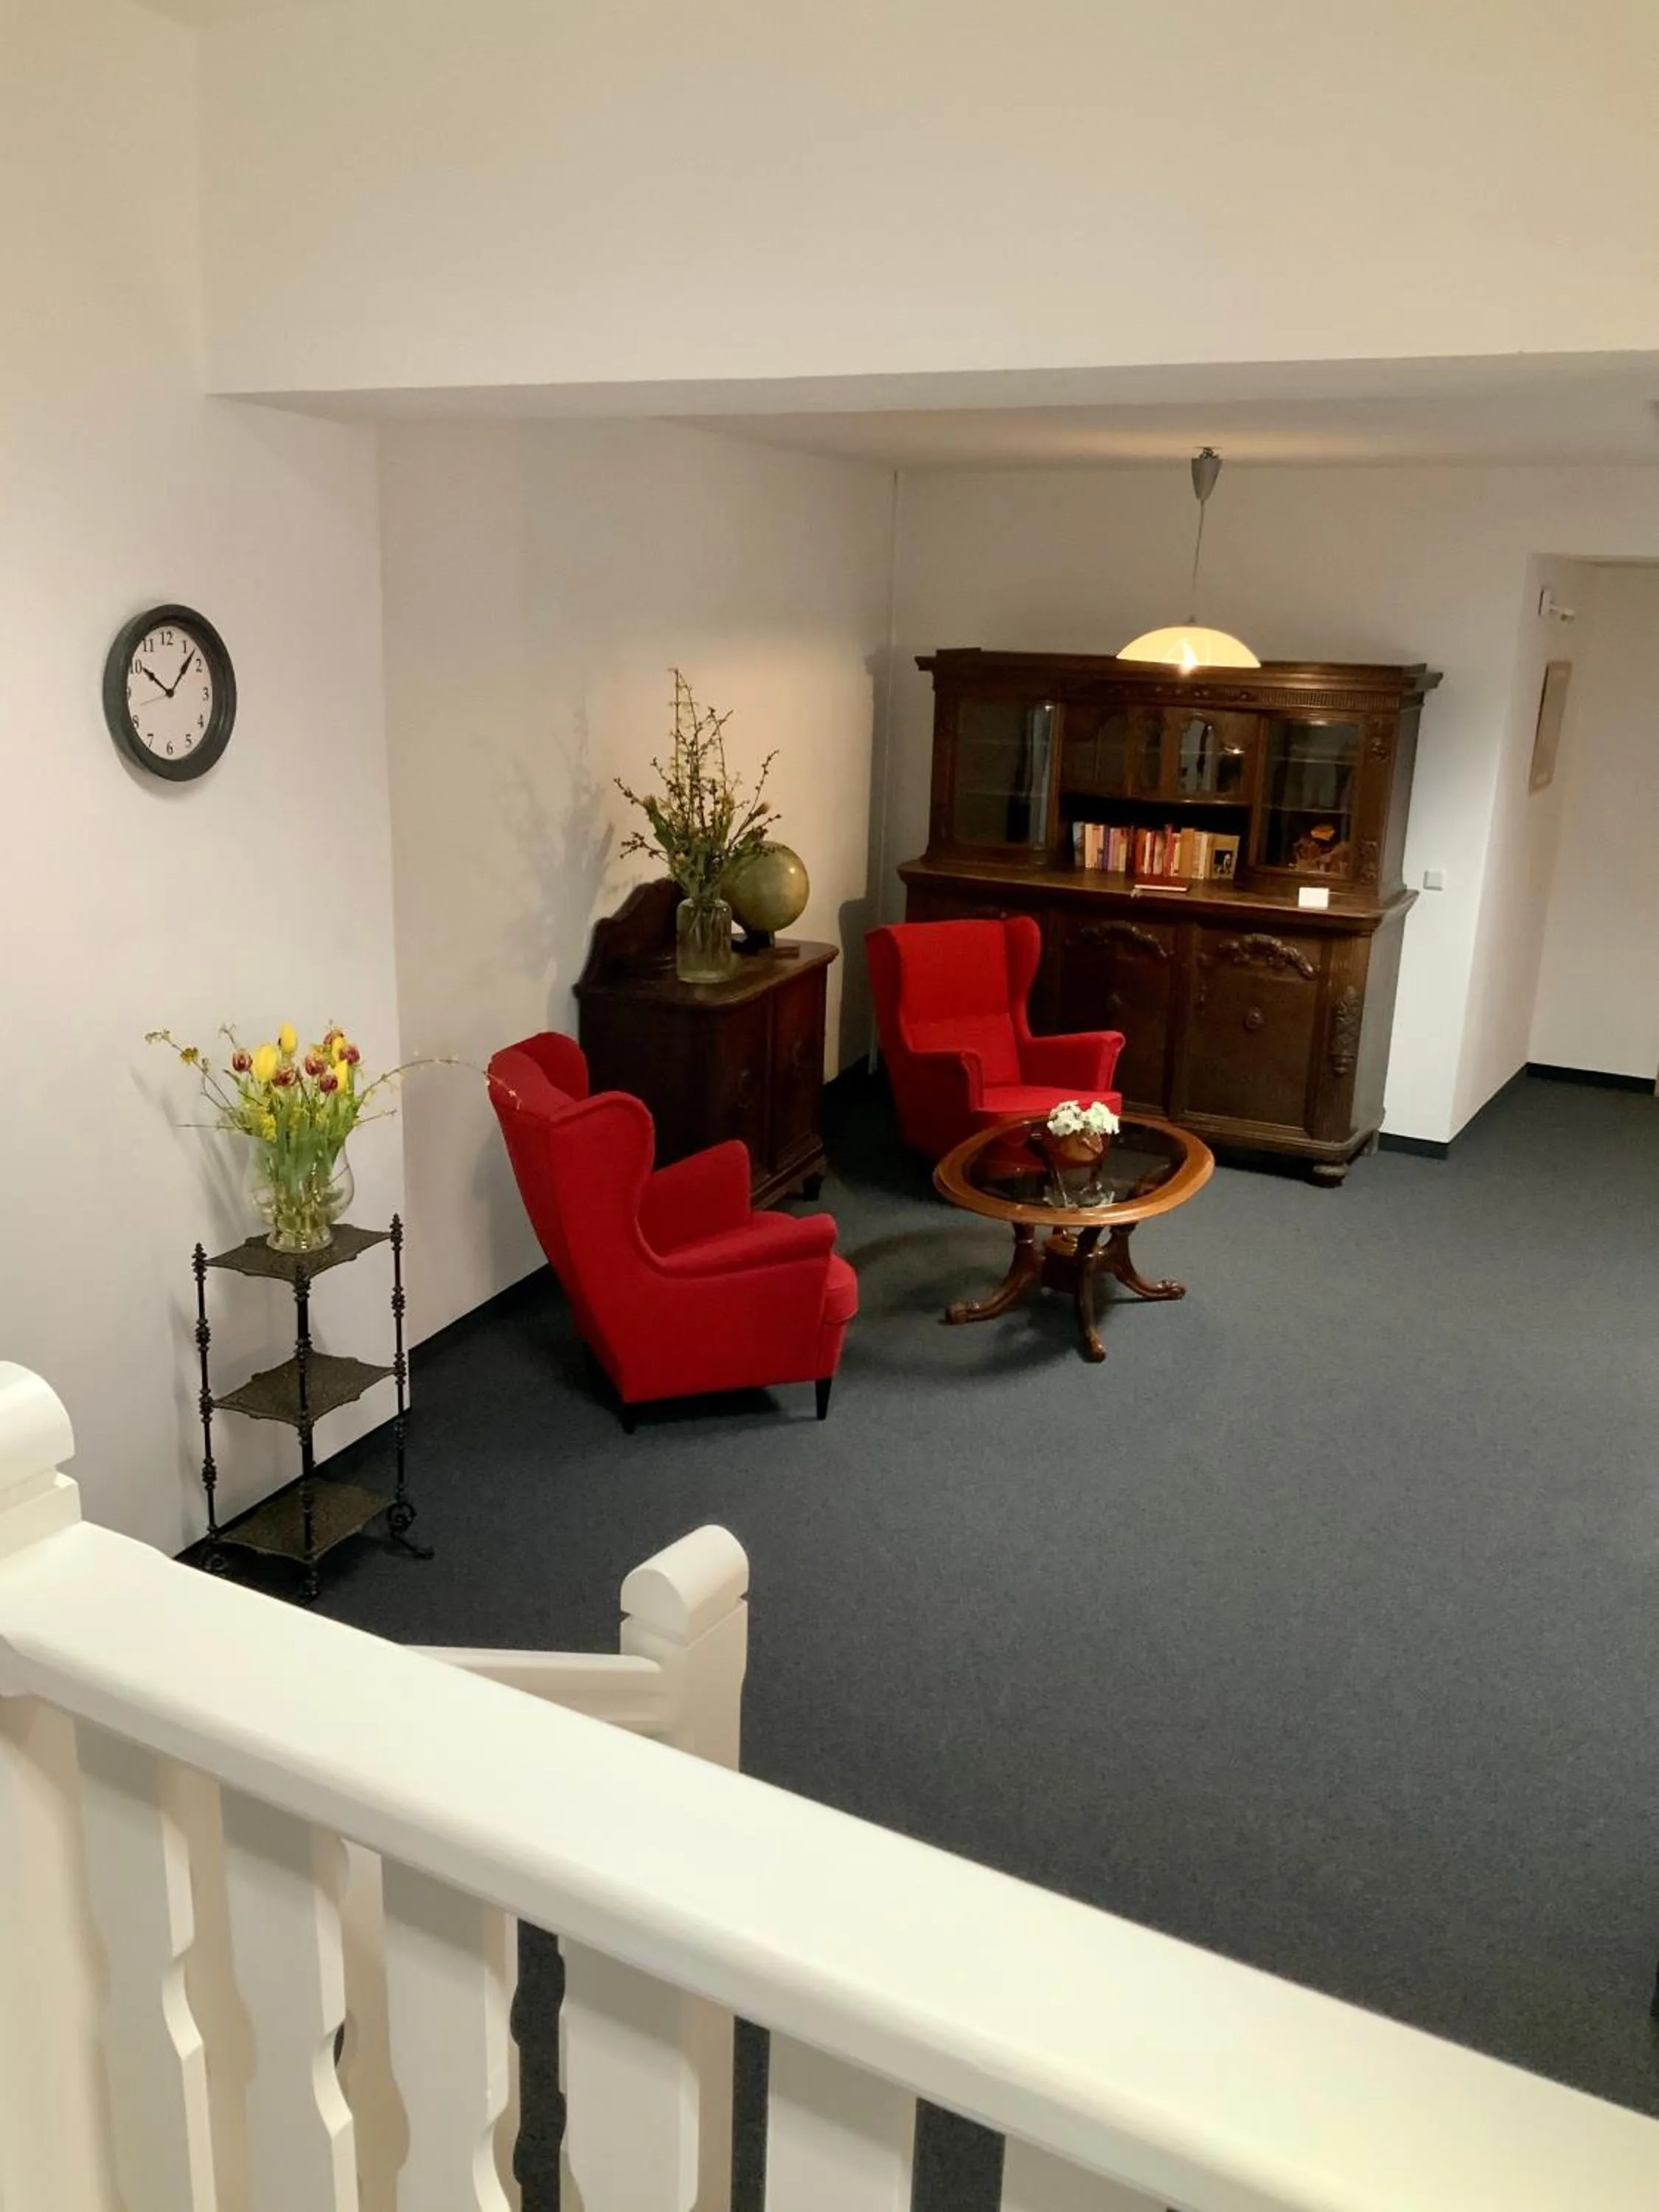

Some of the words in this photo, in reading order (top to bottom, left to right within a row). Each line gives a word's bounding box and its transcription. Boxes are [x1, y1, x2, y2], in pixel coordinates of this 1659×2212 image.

[159, 630, 174, 646] 12
[142, 639, 154, 653] 11
[182, 640, 187, 653] 1
[131, 659, 142, 674] 10
[195, 658, 202, 672] 2
[203, 687, 209, 701] 3
[133, 714, 139, 728] 8
[197, 714, 204, 728] 4
[147, 734, 154, 748] 7
[167, 741, 173, 755] 6
[185, 734, 192, 748] 5
